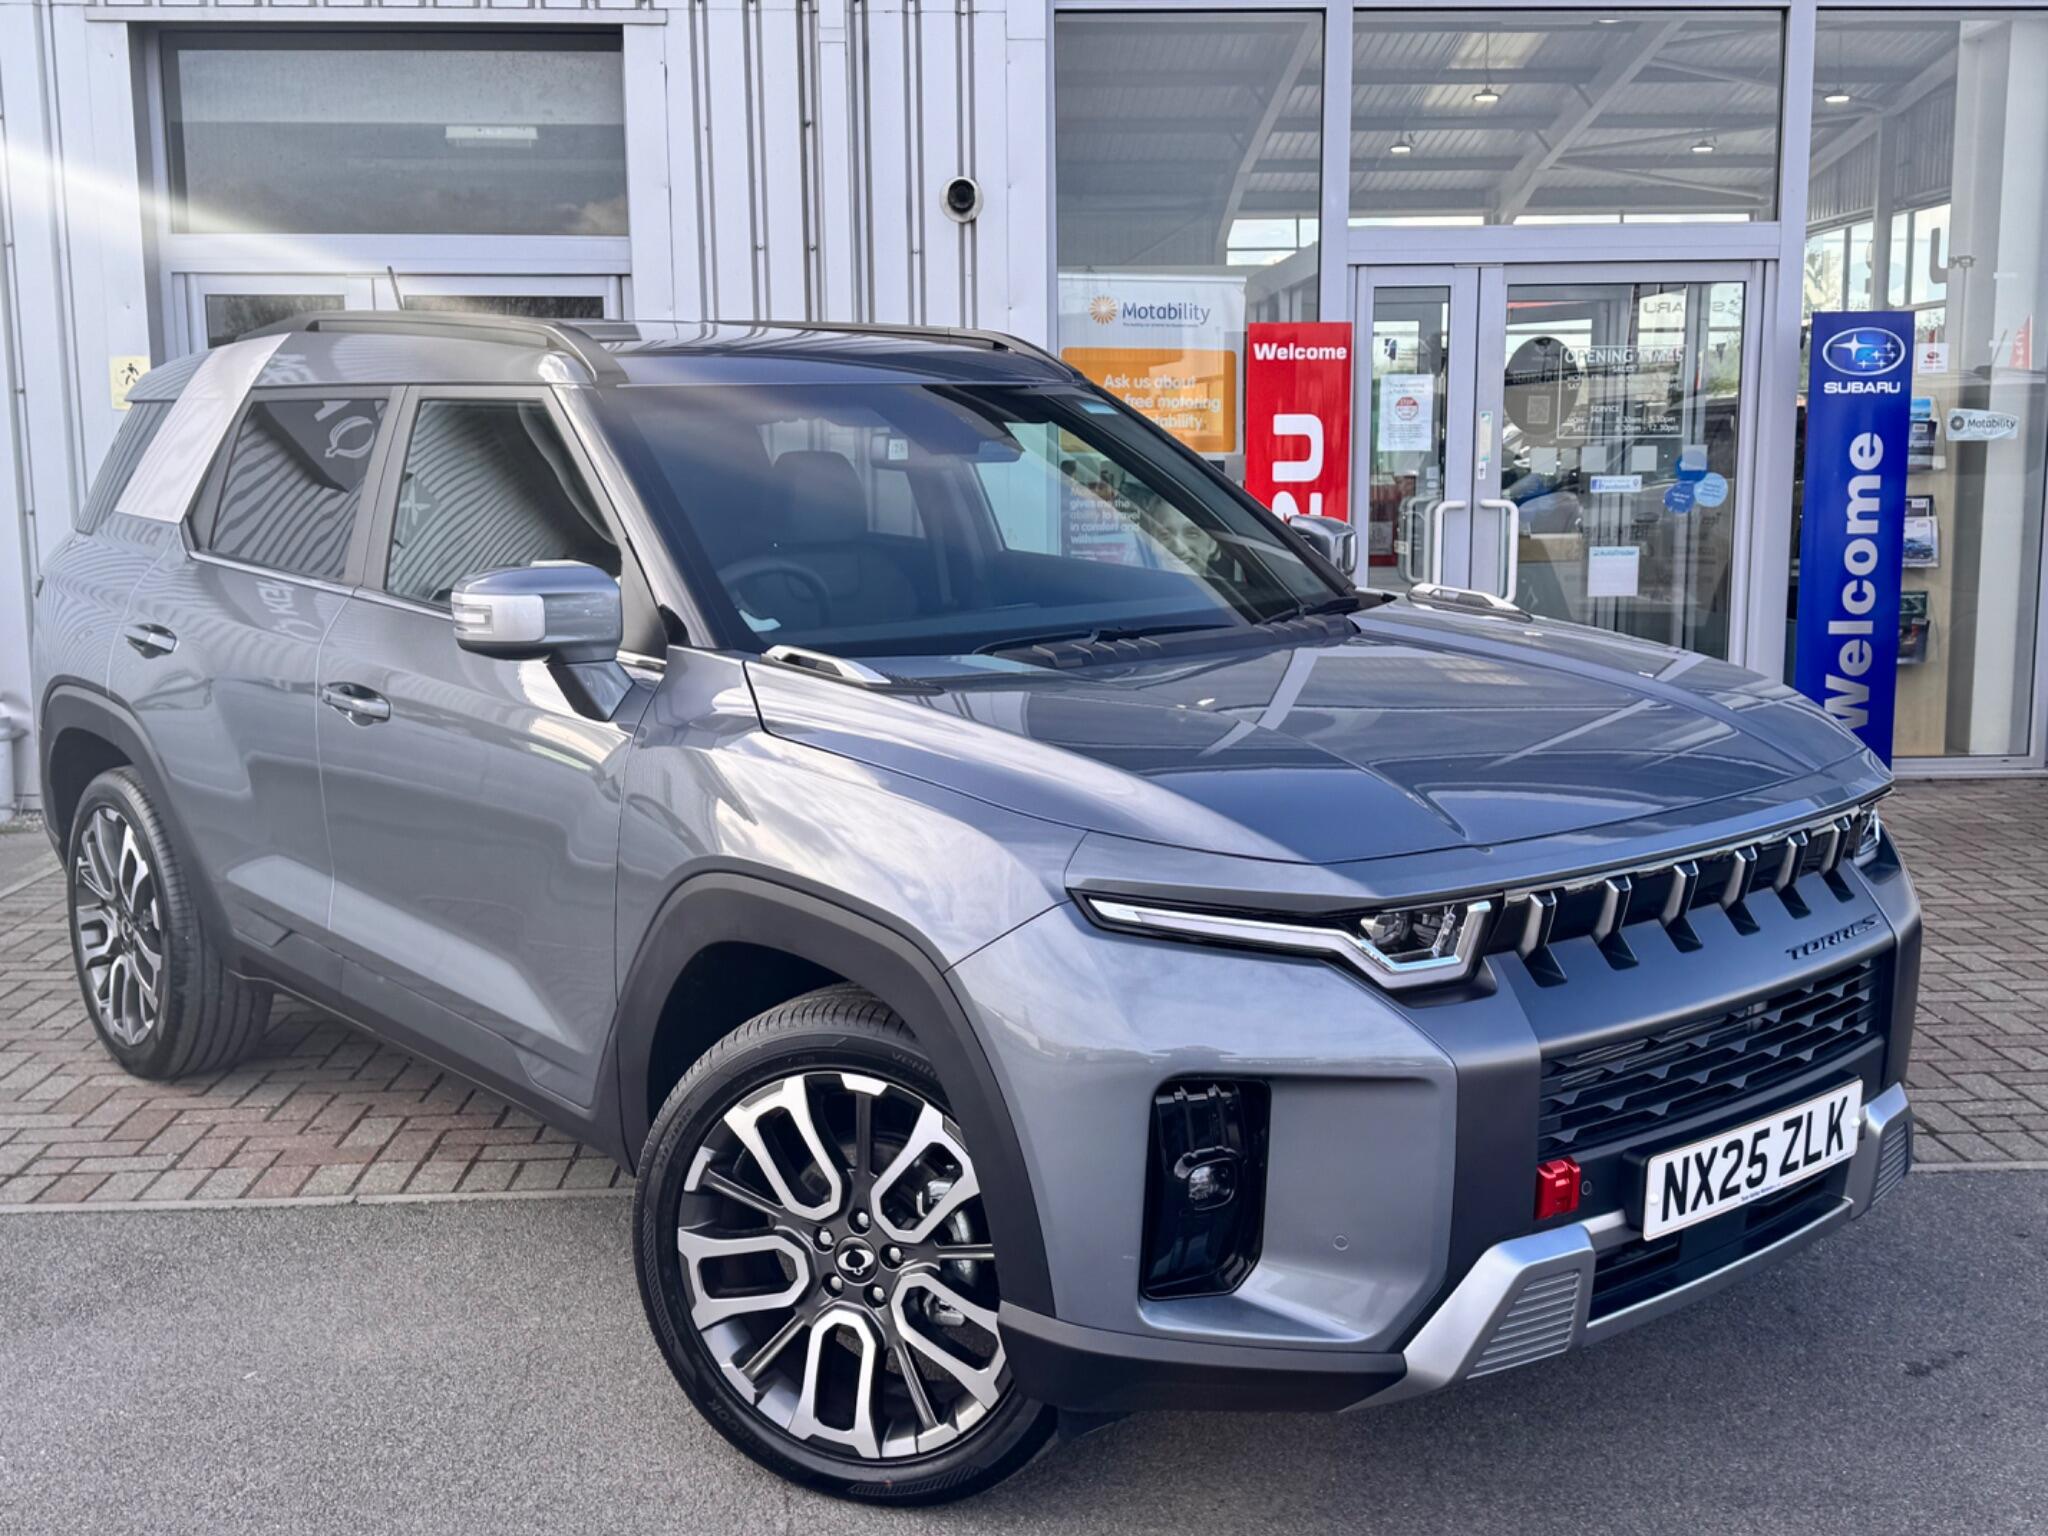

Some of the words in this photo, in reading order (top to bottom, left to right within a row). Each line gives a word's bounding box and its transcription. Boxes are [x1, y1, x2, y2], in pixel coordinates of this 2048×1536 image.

[1122, 302, 1211, 325] Motability
[1253, 343, 1348, 360] Welcome
[1564, 349, 1633, 363] OPENING
[1104, 373, 1131, 388] Ask
[1134, 377, 1151, 388] us
[1154, 374, 1195, 388] about
[1823, 381, 1901, 394] SUBARU
[1157, 395, 1219, 412] motoring
[1967, 419, 2016, 430] Motability
[1824, 432, 1884, 730] Welcome
[1785, 913, 1878, 960] TORRES
[1662, 1127, 1770, 1223] NX25
[1779, 1096, 1849, 1178] ZLK
